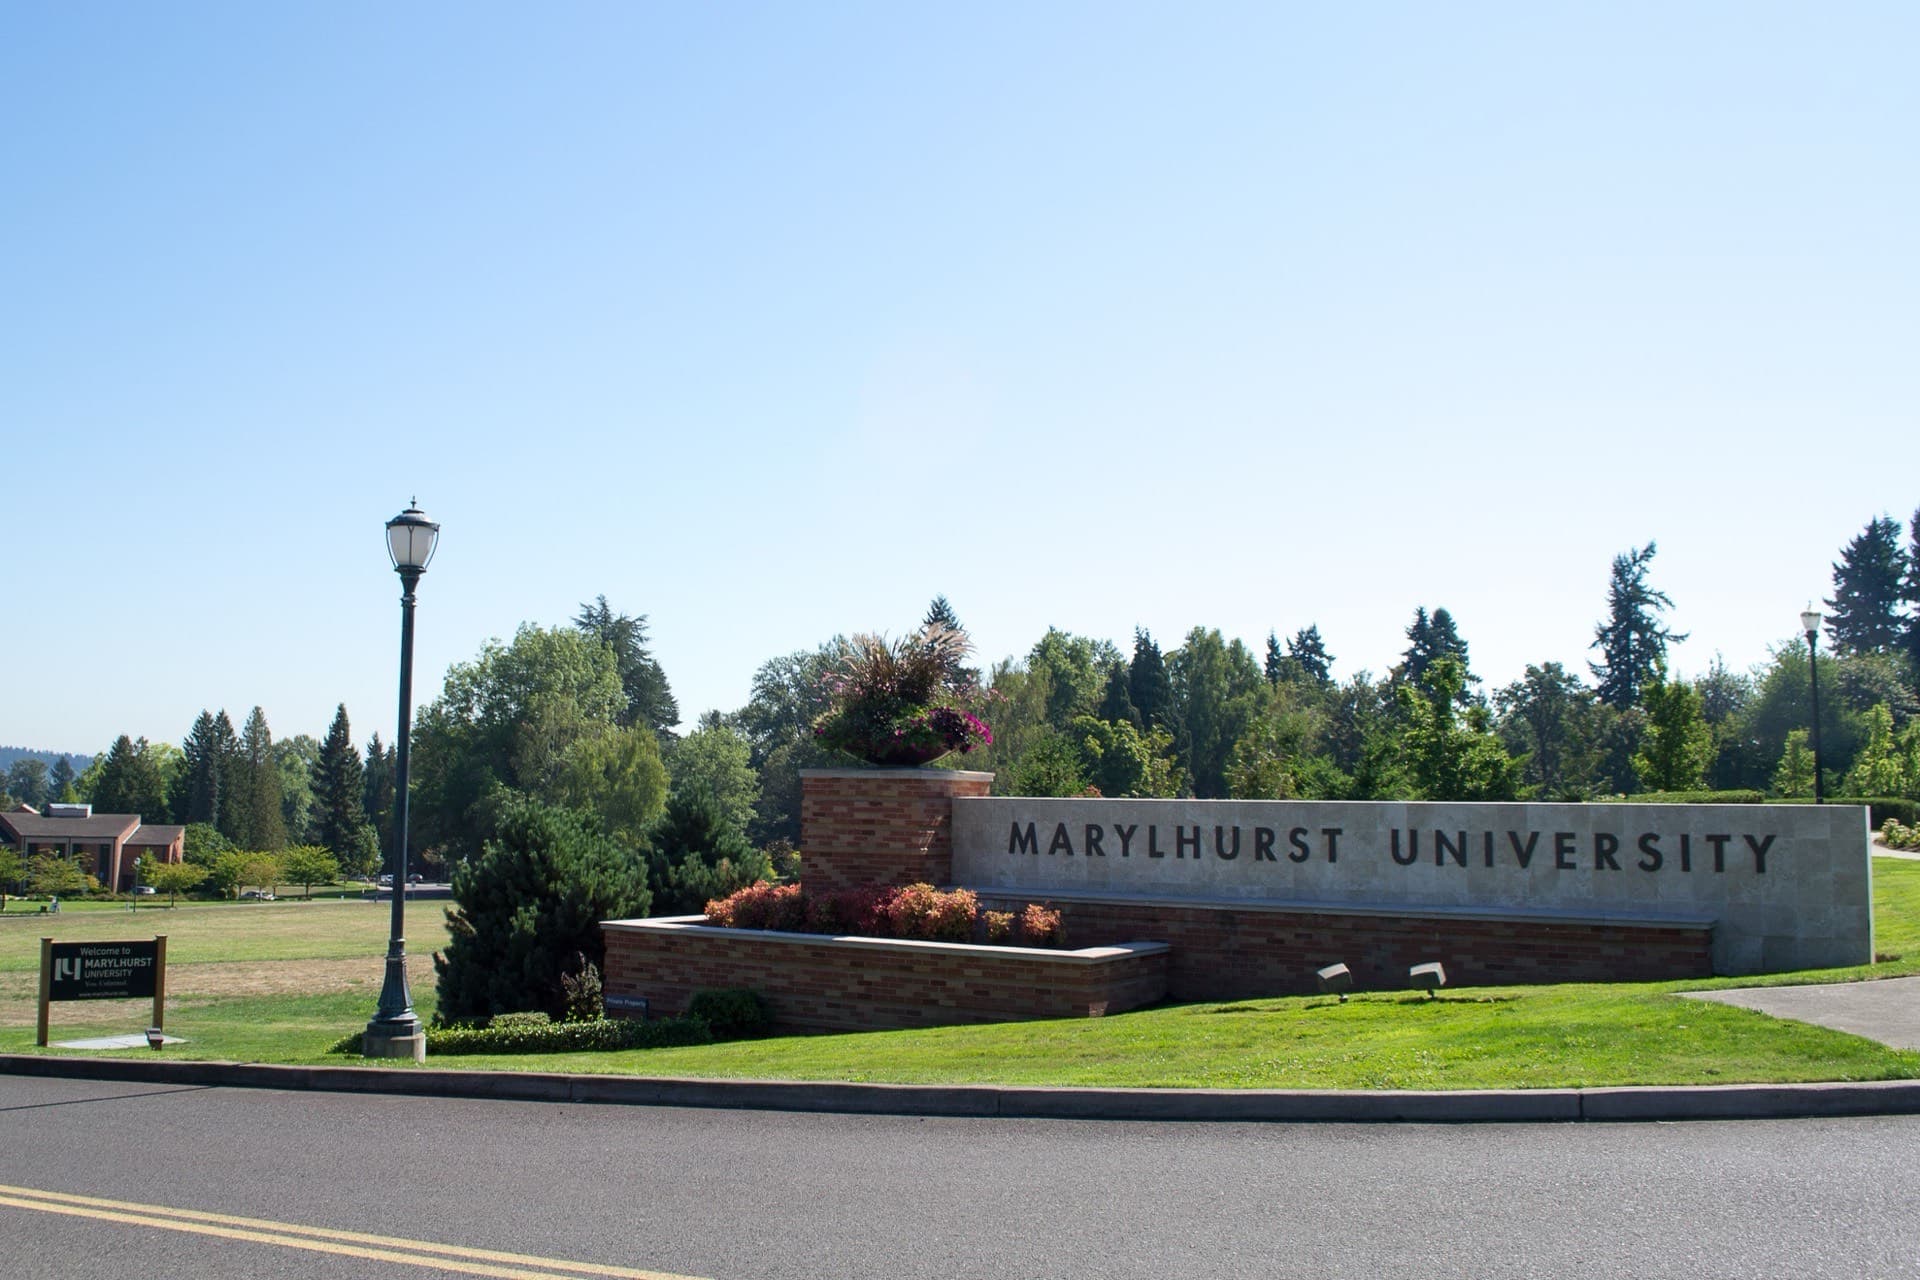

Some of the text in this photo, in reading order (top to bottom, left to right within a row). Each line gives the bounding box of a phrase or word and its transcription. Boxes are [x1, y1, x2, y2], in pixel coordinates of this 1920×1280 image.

[1007, 821, 1777, 874] MARYLHURST UNIVERSITY
[80, 946, 131, 957] Welcome to
[84, 957, 153, 969] MARYLHURST
[84, 968, 133, 979] UNIVERSITY
